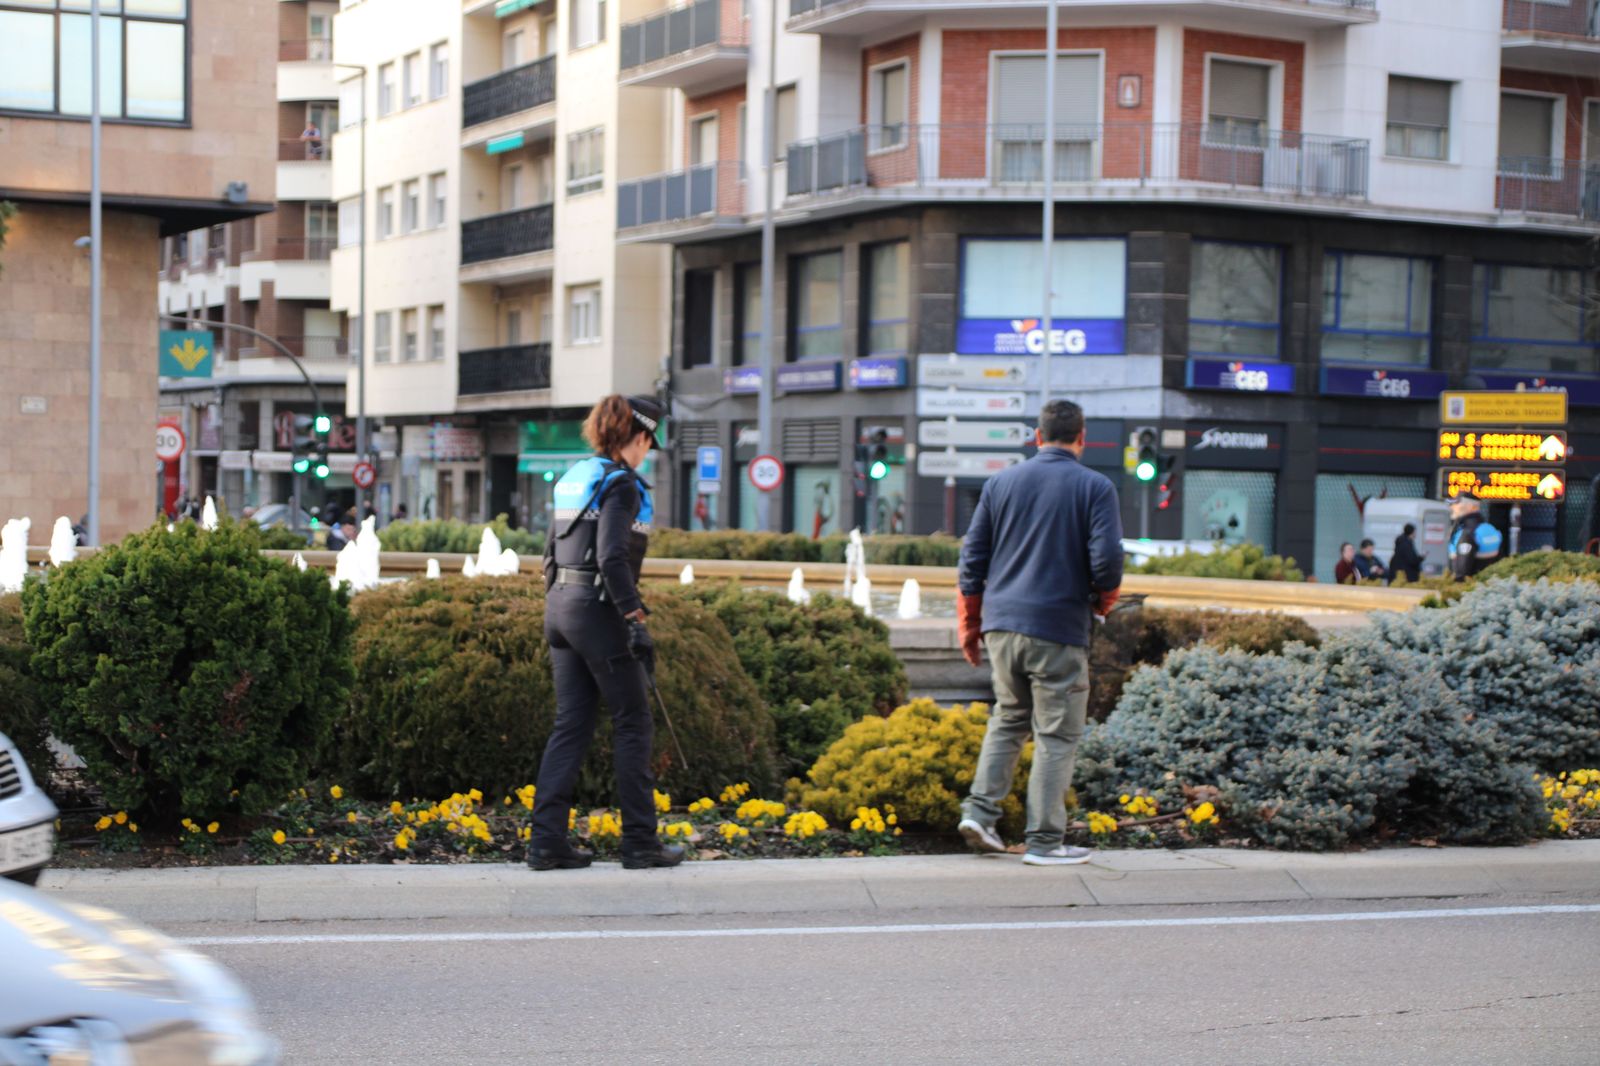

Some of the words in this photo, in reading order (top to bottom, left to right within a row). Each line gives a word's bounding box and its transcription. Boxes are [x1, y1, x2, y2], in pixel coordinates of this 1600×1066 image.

[1025, 329, 1086, 354] CEG
[1235, 370, 1268, 391] CEG
[1381, 378, 1410, 398] CEG
[157, 434, 177, 448] 30
